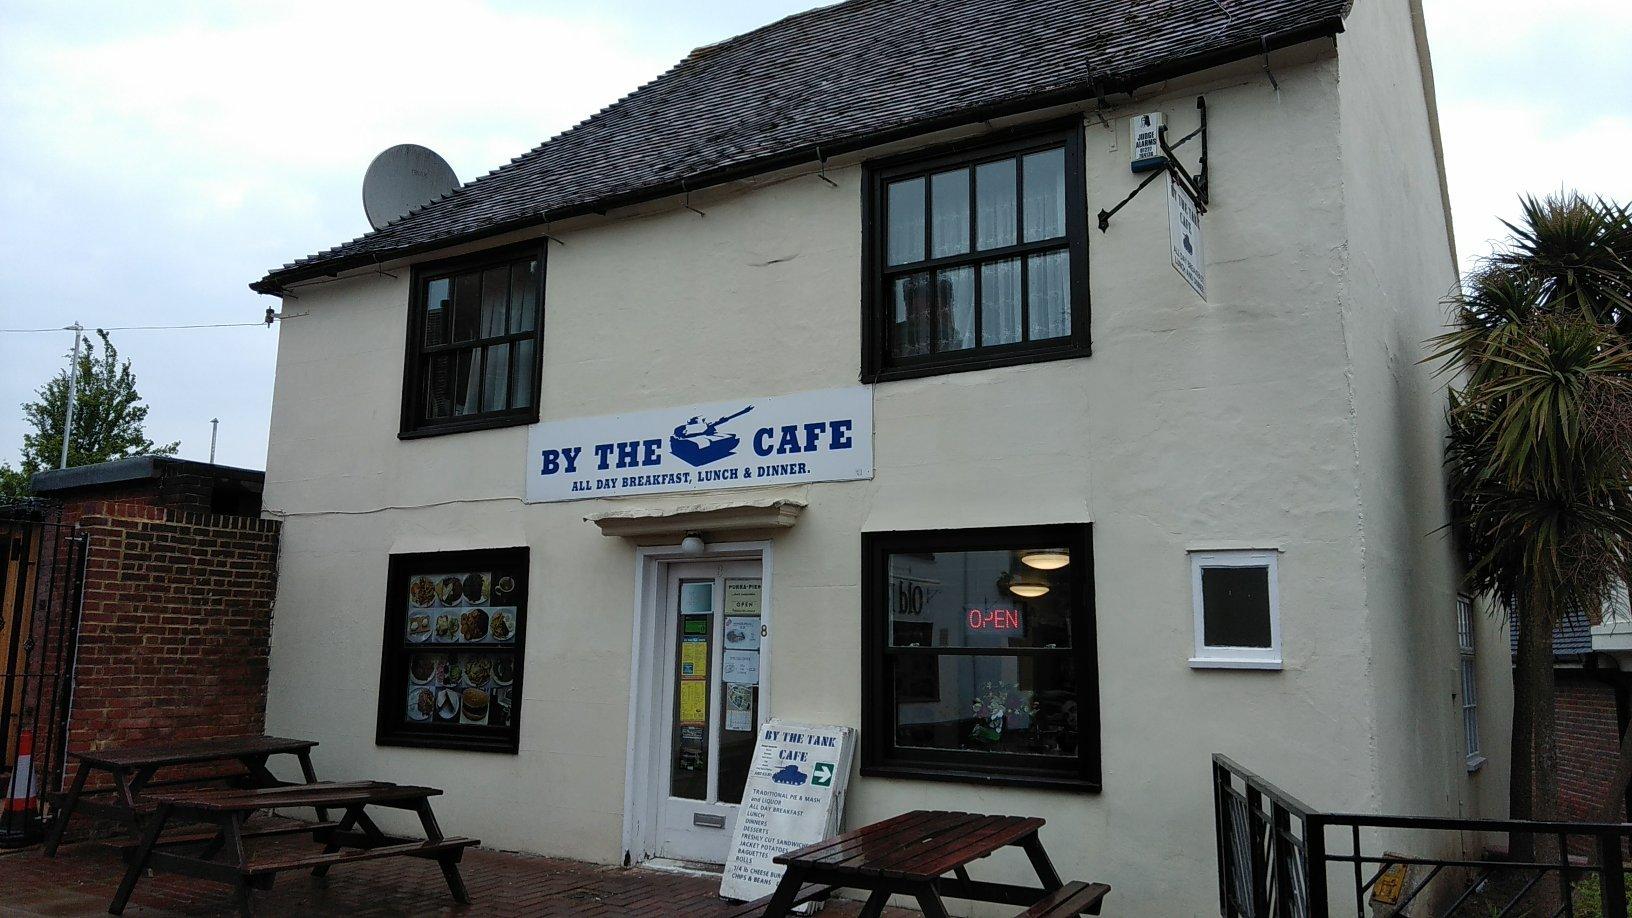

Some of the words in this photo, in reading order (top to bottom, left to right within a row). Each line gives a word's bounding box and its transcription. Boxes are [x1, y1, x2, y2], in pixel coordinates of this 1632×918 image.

[1138, 131, 1155, 141] JUDGE
[1136, 138, 1157, 148] ALARMS
[541, 447, 581, 475] BY
[594, 439, 662, 471] THE
[753, 419, 852, 457] CAFE
[572, 480, 592, 492] ALL
[596, 478, 617, 490] DAY
[622, 473, 692, 488] BREAKFAST,
[697, 468, 738, 483] LUNCH
[743, 467, 752, 478] &
[756, 463, 811, 478] DINNER.
[968, 609, 1018, 629] OPEN
[760, 624, 767, 637] 8
[765, 730, 780, 740] BY
[783, 732, 805, 744] THE
[807, 734, 837, 747] TANK
[779, 749, 808, 762] CAFE
[753, 789, 788, 799] TRADITIONAL
[761, 798, 782, 806] LIQUOR
[746, 810, 765, 818] LUNCH
[773, 807, 804, 816] BREAKFAST
[745, 818, 768, 827] DINNERS
[743, 826, 769, 835] DESSERTS
[741, 834, 764, 843] FRESHLY
[776, 838, 809, 849] SANDWICHE
[739, 841, 760, 849] JACKET
[760, 844, 788, 853] POTATOES
[738, 848, 769, 859] BAGUETTES
[736, 855, 752, 864] ROLLS
[750, 868, 770, 877] CHEESE
[753, 876, 772, 885] BEANS
